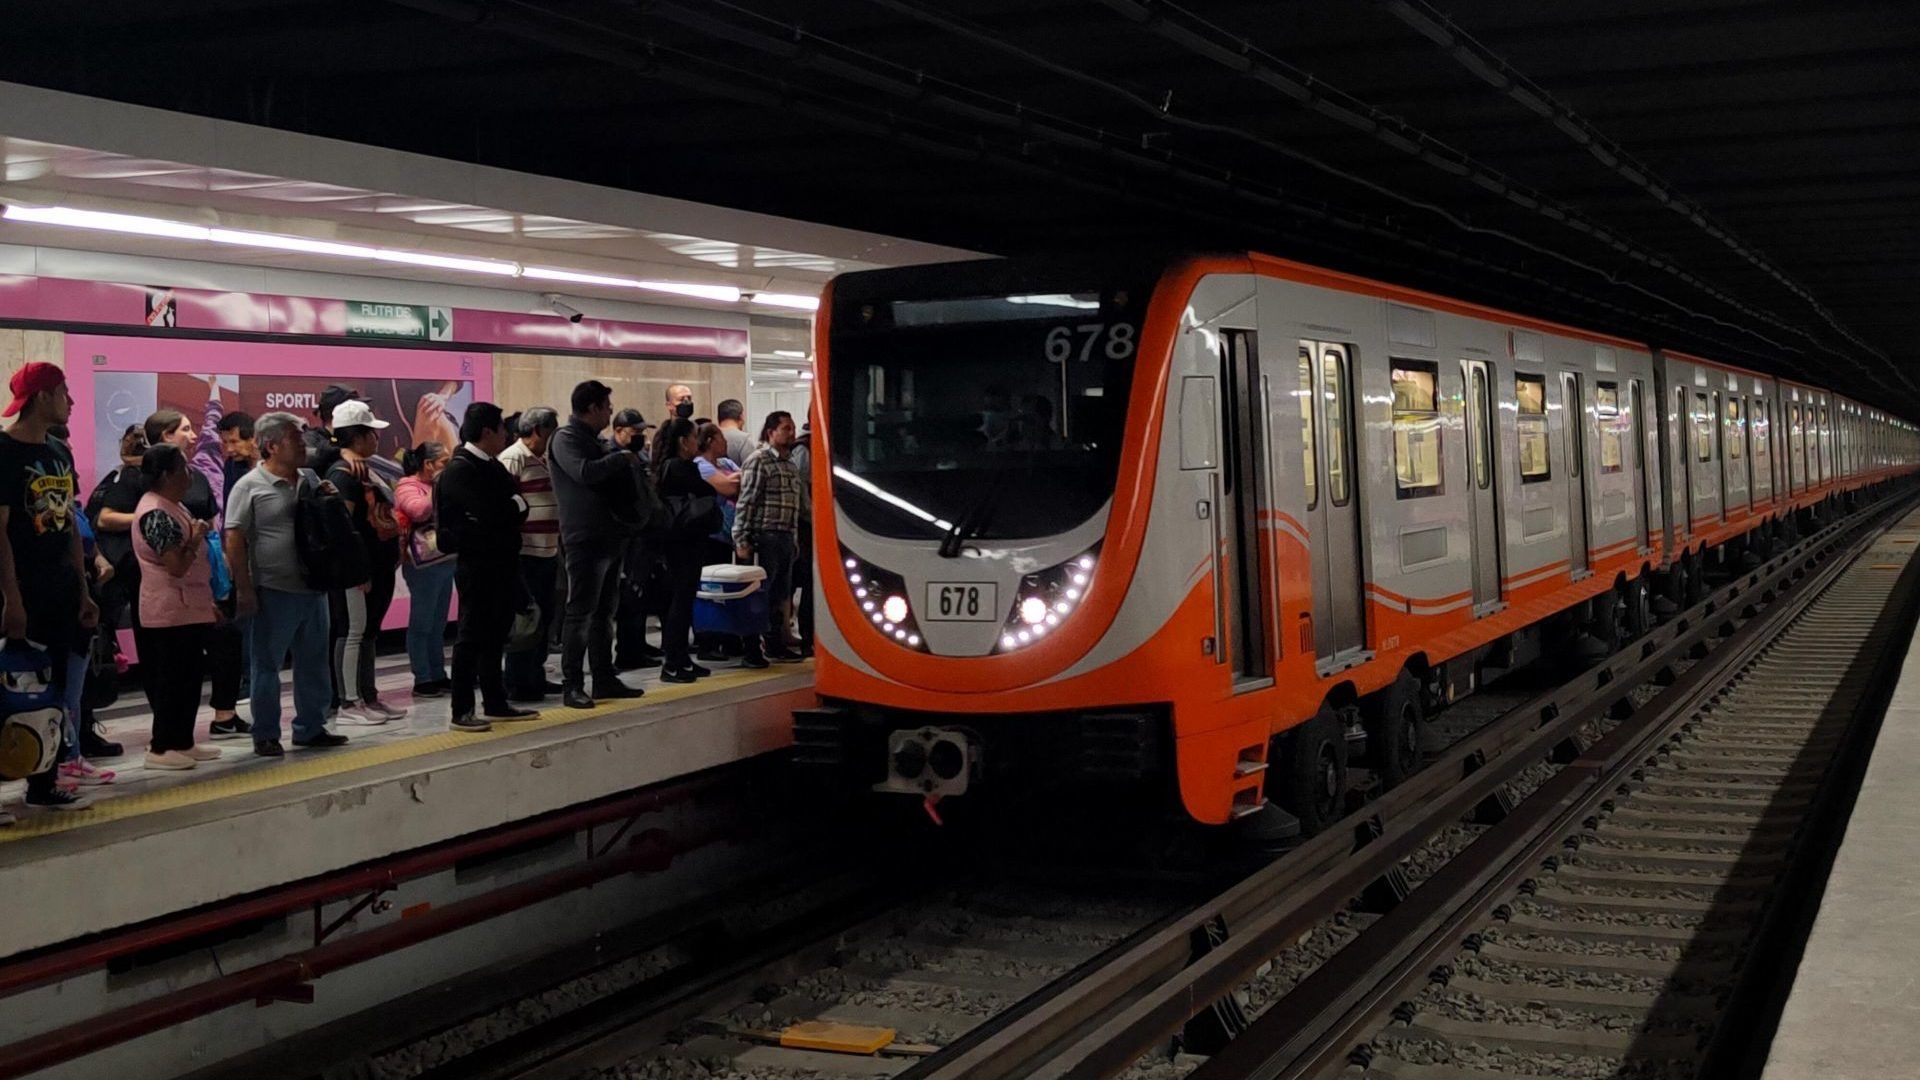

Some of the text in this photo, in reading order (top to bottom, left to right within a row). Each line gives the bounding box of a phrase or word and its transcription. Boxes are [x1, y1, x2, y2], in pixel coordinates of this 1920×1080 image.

[361, 303, 393, 317] RUTA
[1045, 322, 1135, 362] 678
[940, 586, 979, 616] 678
